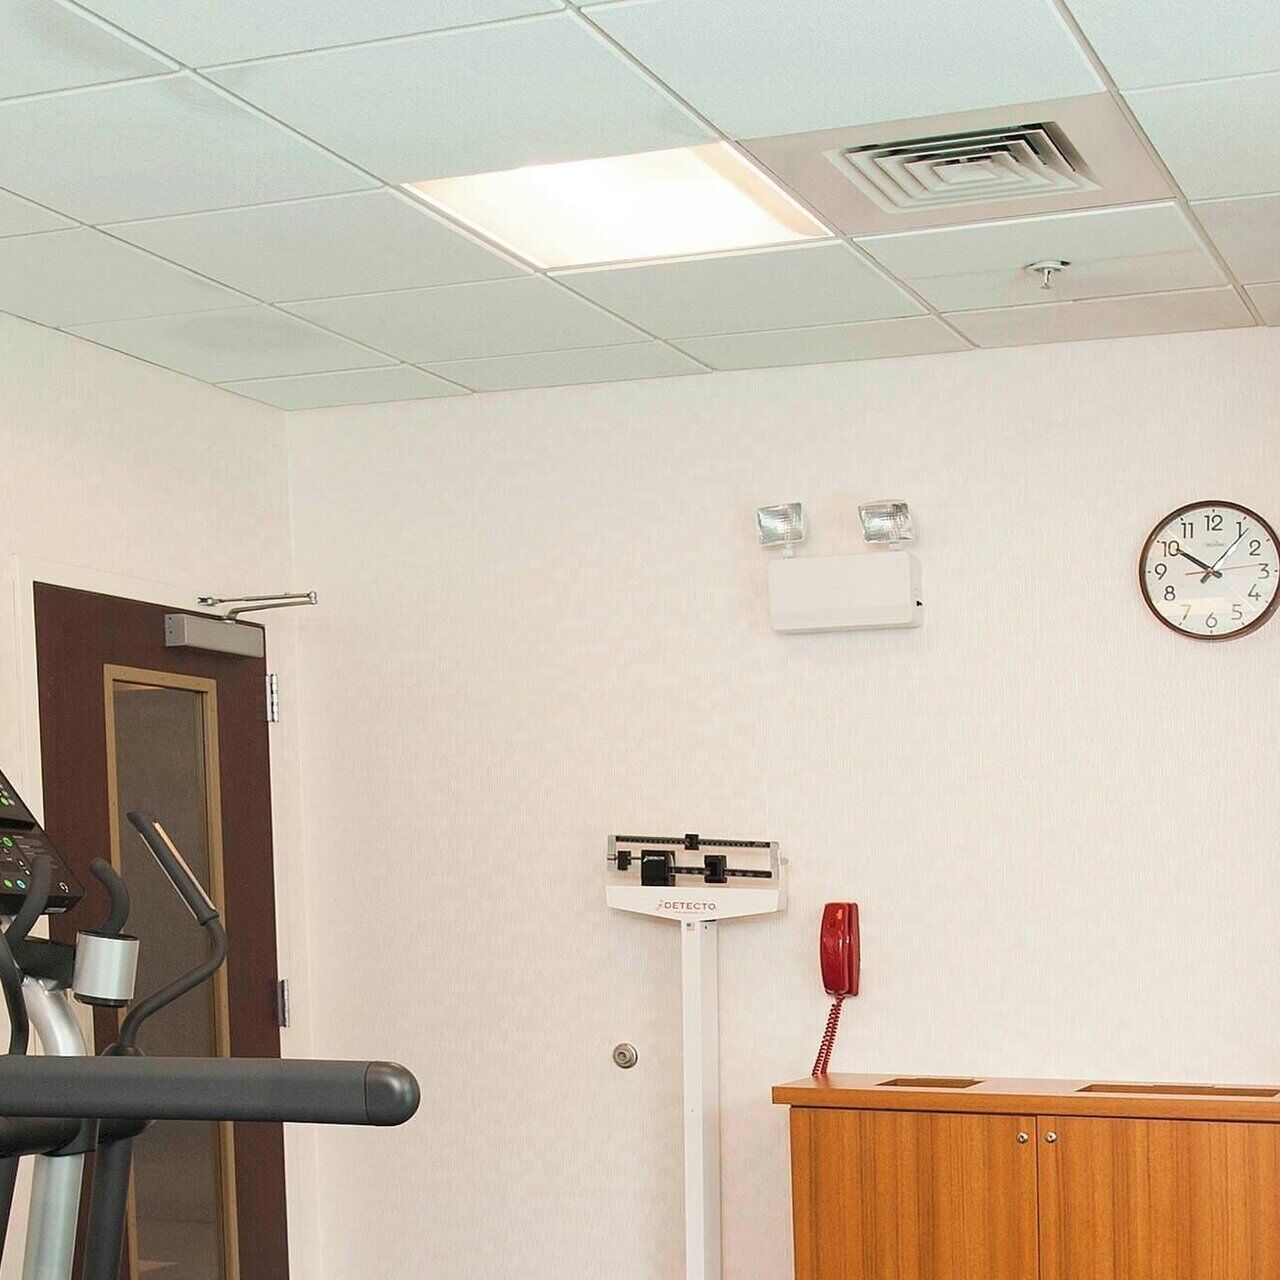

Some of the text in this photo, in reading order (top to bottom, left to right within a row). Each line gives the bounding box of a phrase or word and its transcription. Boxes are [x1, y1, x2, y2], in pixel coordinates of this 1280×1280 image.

[1181, 522, 1194, 539] 11
[1204, 515, 1223, 532] 12
[1236, 521, 1243, 538] 1
[1162, 540, 1180, 557] 10
[1249, 539, 1261, 556] 2
[1155, 563, 1167, 581] 9
[1258, 563, 1270, 580] 3
[1164, 585, 1176, 601] 8
[1248, 583, 1261, 601] 4
[1180, 604, 1191, 620] 7
[1205, 613, 1218, 628] 6
[1232, 604, 1243, 620] 5
[664, 901, 717, 911] DETECTO
